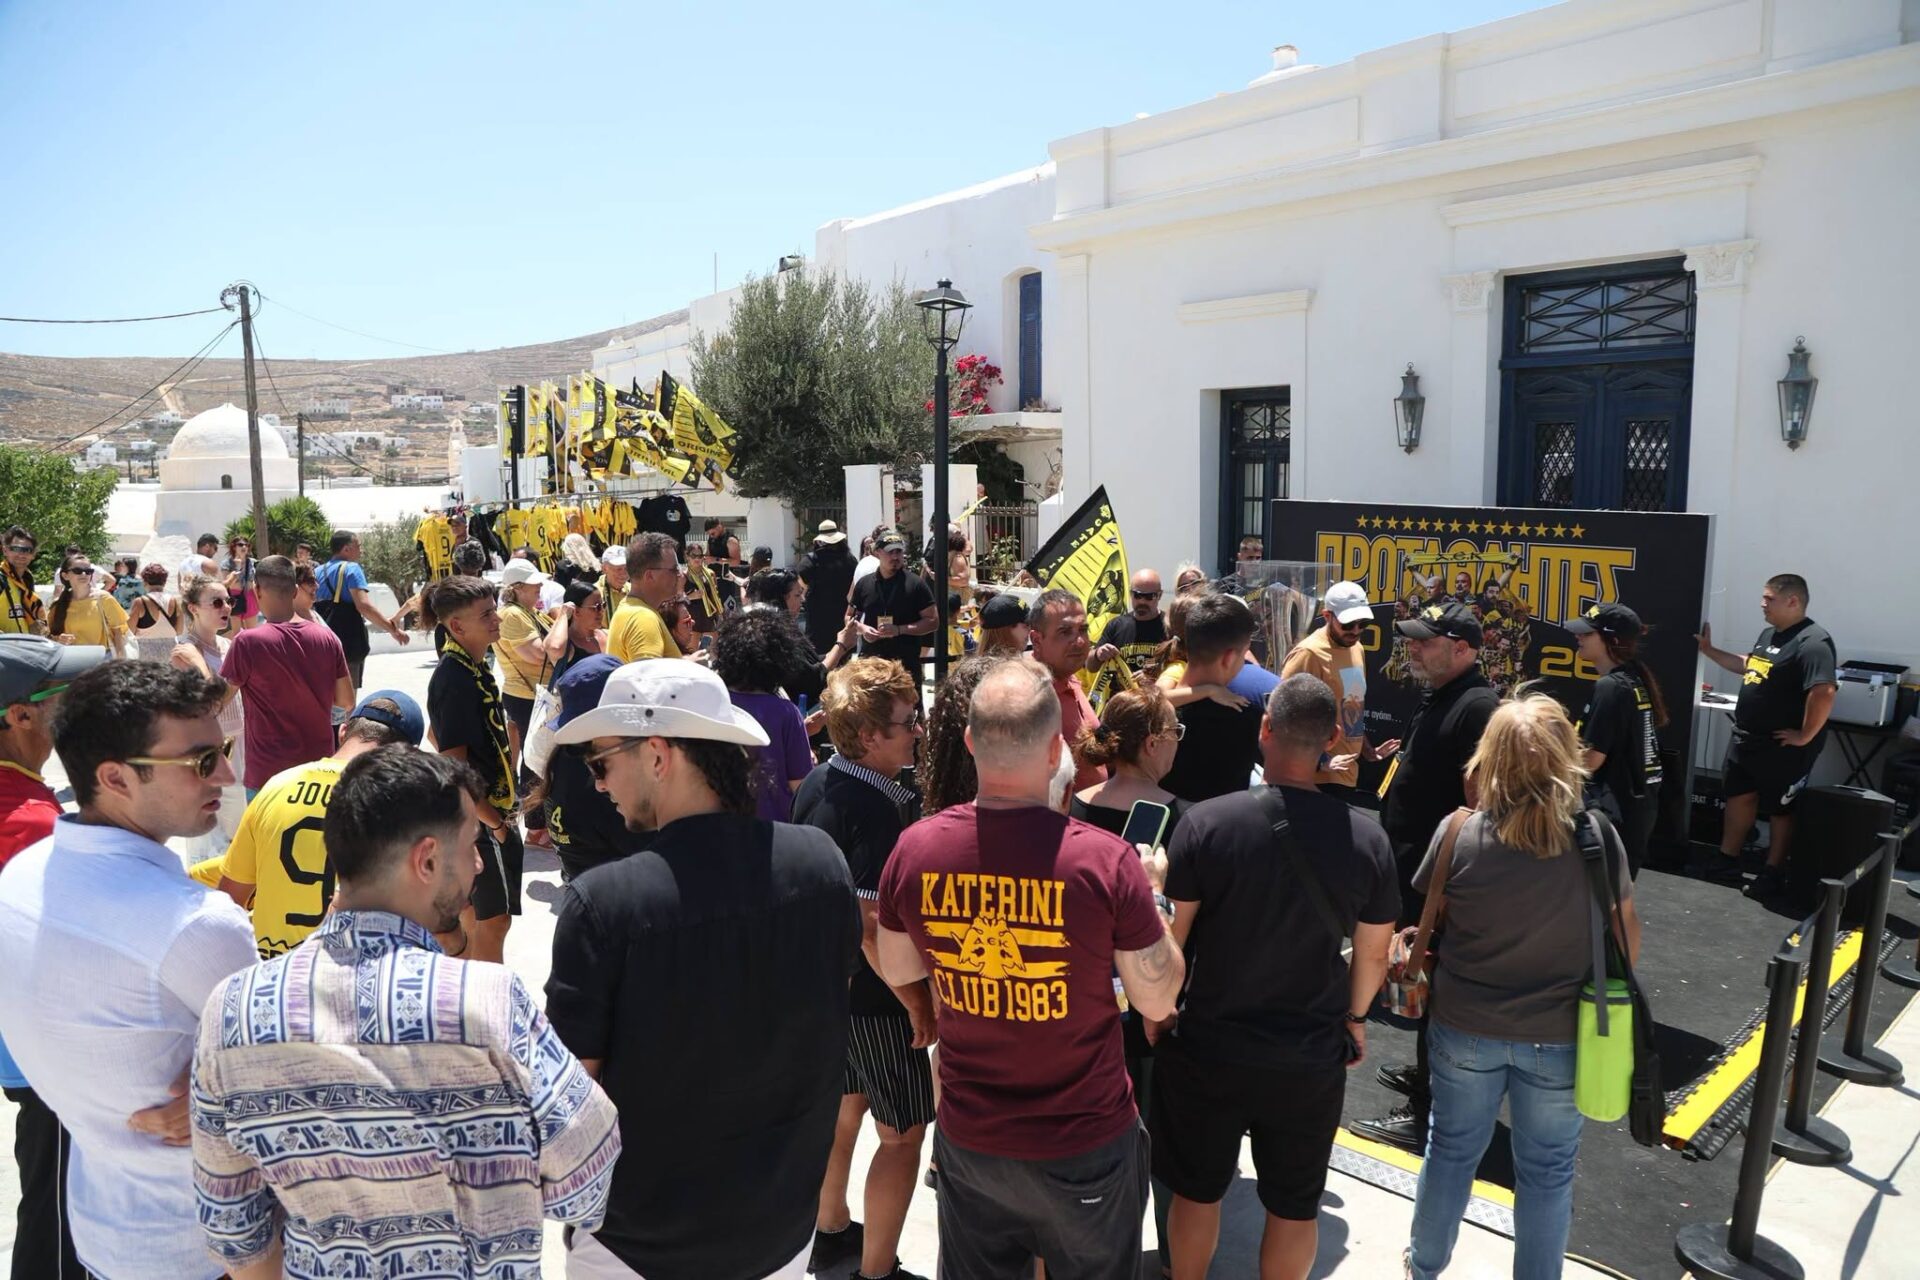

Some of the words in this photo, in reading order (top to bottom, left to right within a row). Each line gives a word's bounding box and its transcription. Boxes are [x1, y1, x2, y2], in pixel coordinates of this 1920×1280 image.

[1070, 518, 1102, 549] GATE
[280, 816, 336, 928] 9
[921, 872, 1065, 926] KATERINI
[933, 967, 1000, 1019] CLUB
[1004, 979, 1068, 1022] 1983
